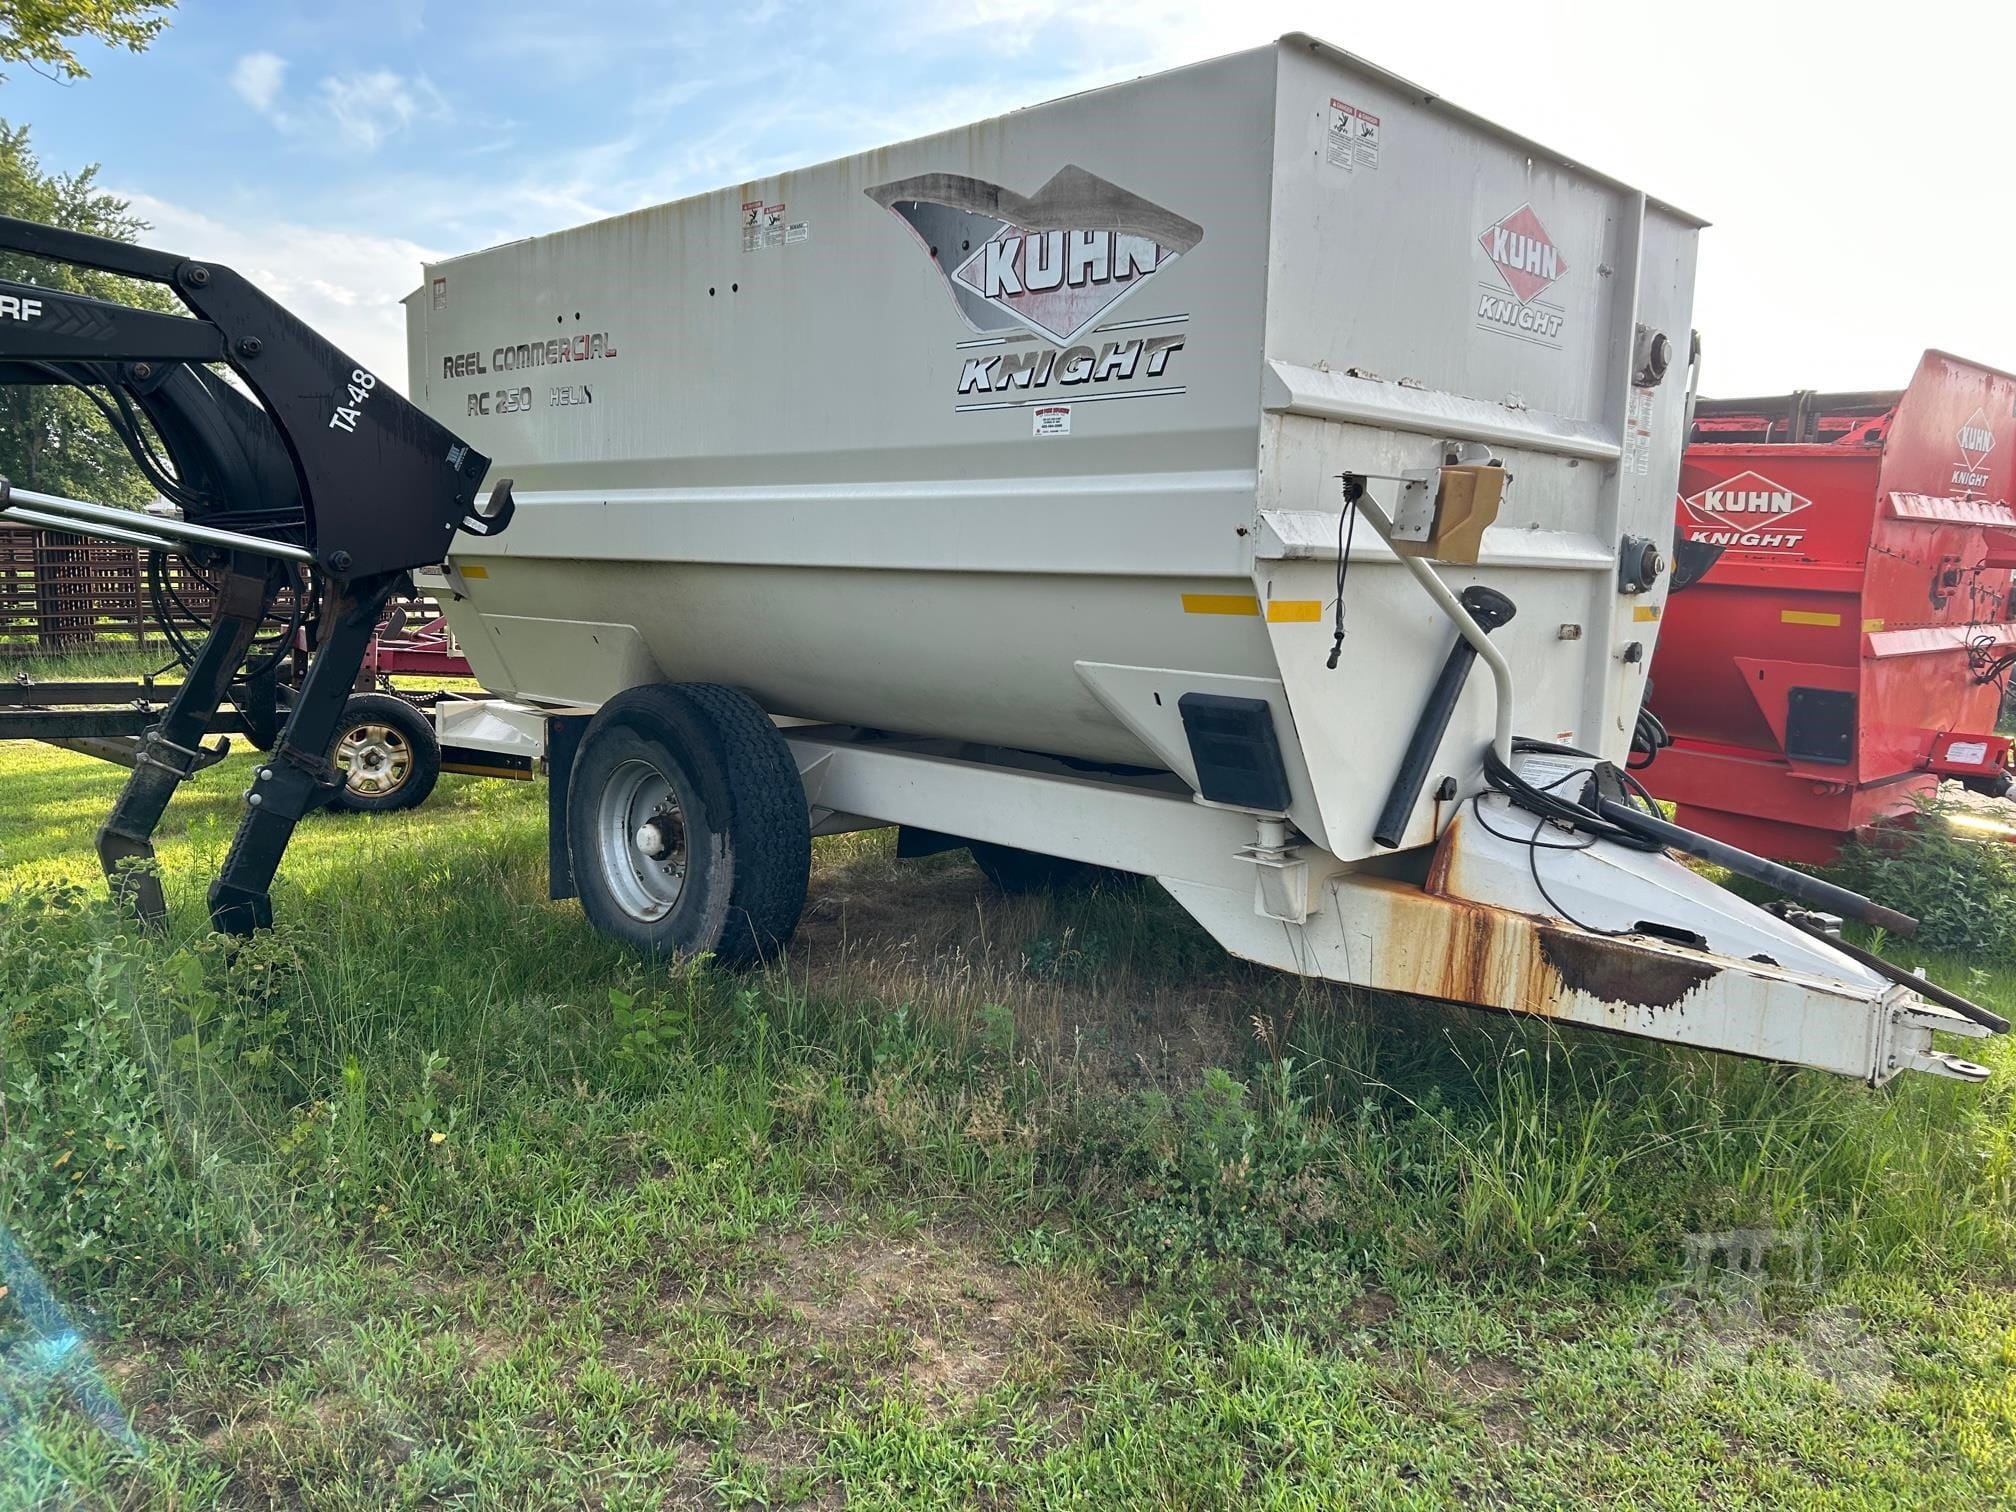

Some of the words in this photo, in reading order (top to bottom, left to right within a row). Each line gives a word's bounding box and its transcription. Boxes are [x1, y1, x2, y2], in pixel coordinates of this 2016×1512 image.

[985, 230, 1159, 298] KUHN
[1492, 225, 1558, 281] KUHN
[1478, 295, 1563, 338] KNIGHT
[443, 351, 487, 379] REEL
[492, 332, 617, 373] COMMERCIAL
[958, 334, 1185, 394] KNIGHT
[328, 369, 376, 433] TA-48
[467, 391, 490, 416] RC
[495, 386, 532, 413] 250
[1961, 426, 1991, 452] KUHN
[1951, 470, 1988, 487] KNIGHT
[1704, 491, 1792, 513] KUHN
[1690, 531, 1803, 548] KNIGHT
